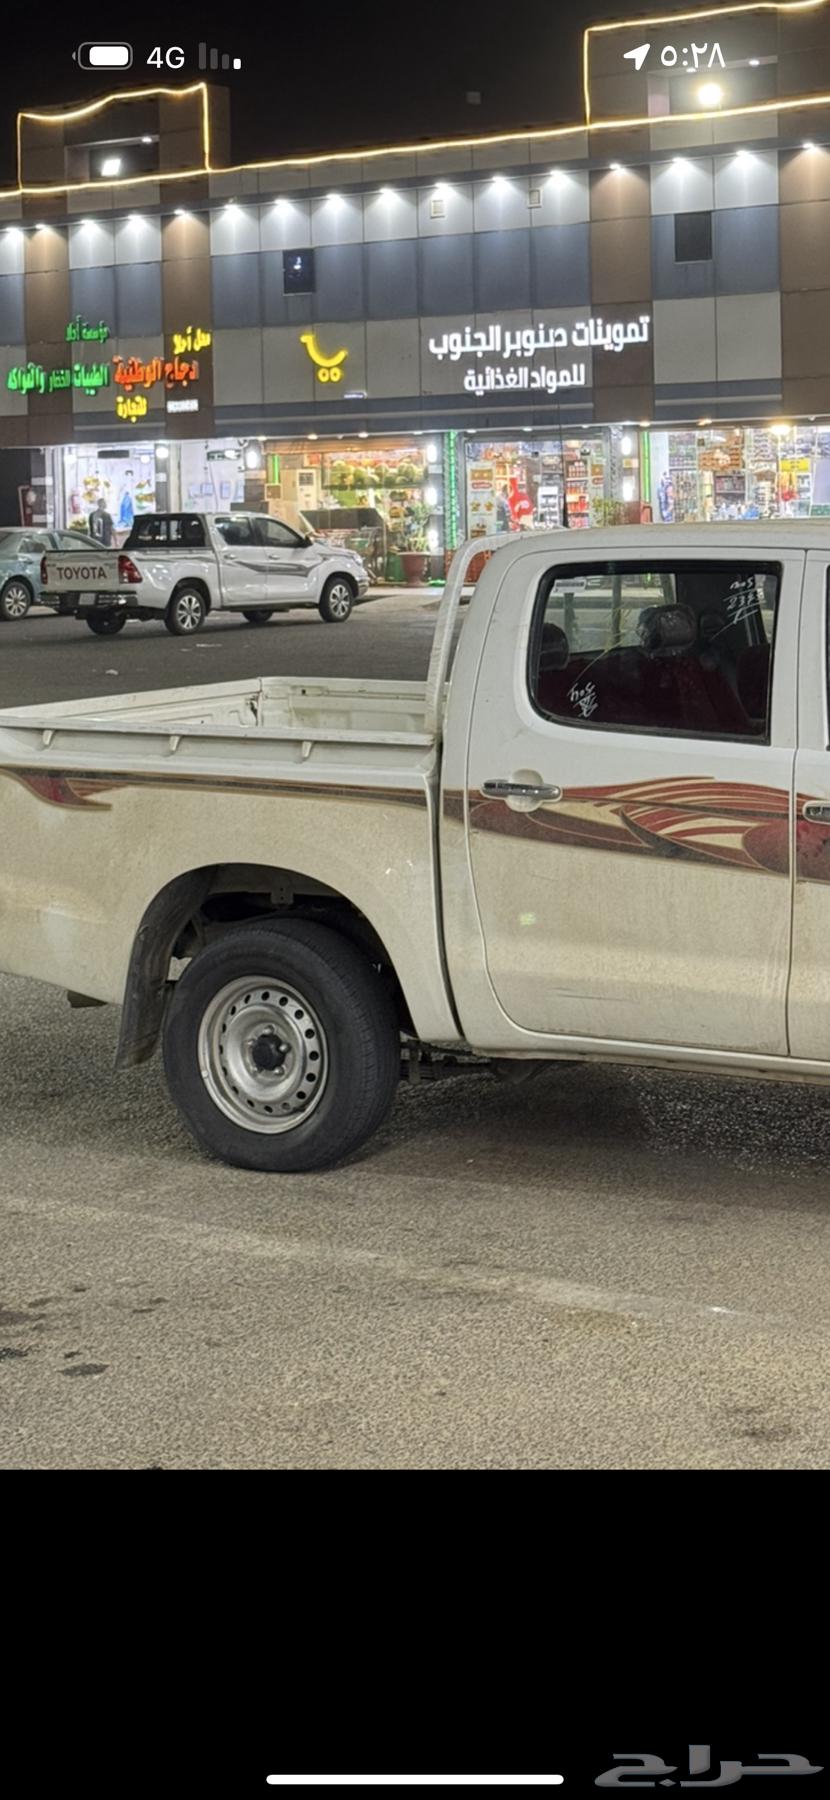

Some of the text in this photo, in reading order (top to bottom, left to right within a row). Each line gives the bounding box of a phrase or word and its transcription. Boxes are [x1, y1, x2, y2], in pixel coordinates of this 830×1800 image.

[428, 316, 650, 361] تموينات صنوبر الجنوب
[112, 356, 199, 391] دجاج الوطنية
[463, 363, 586, 396] للمواد الغذائية
[56, 566, 107, 580] TOYOTA
